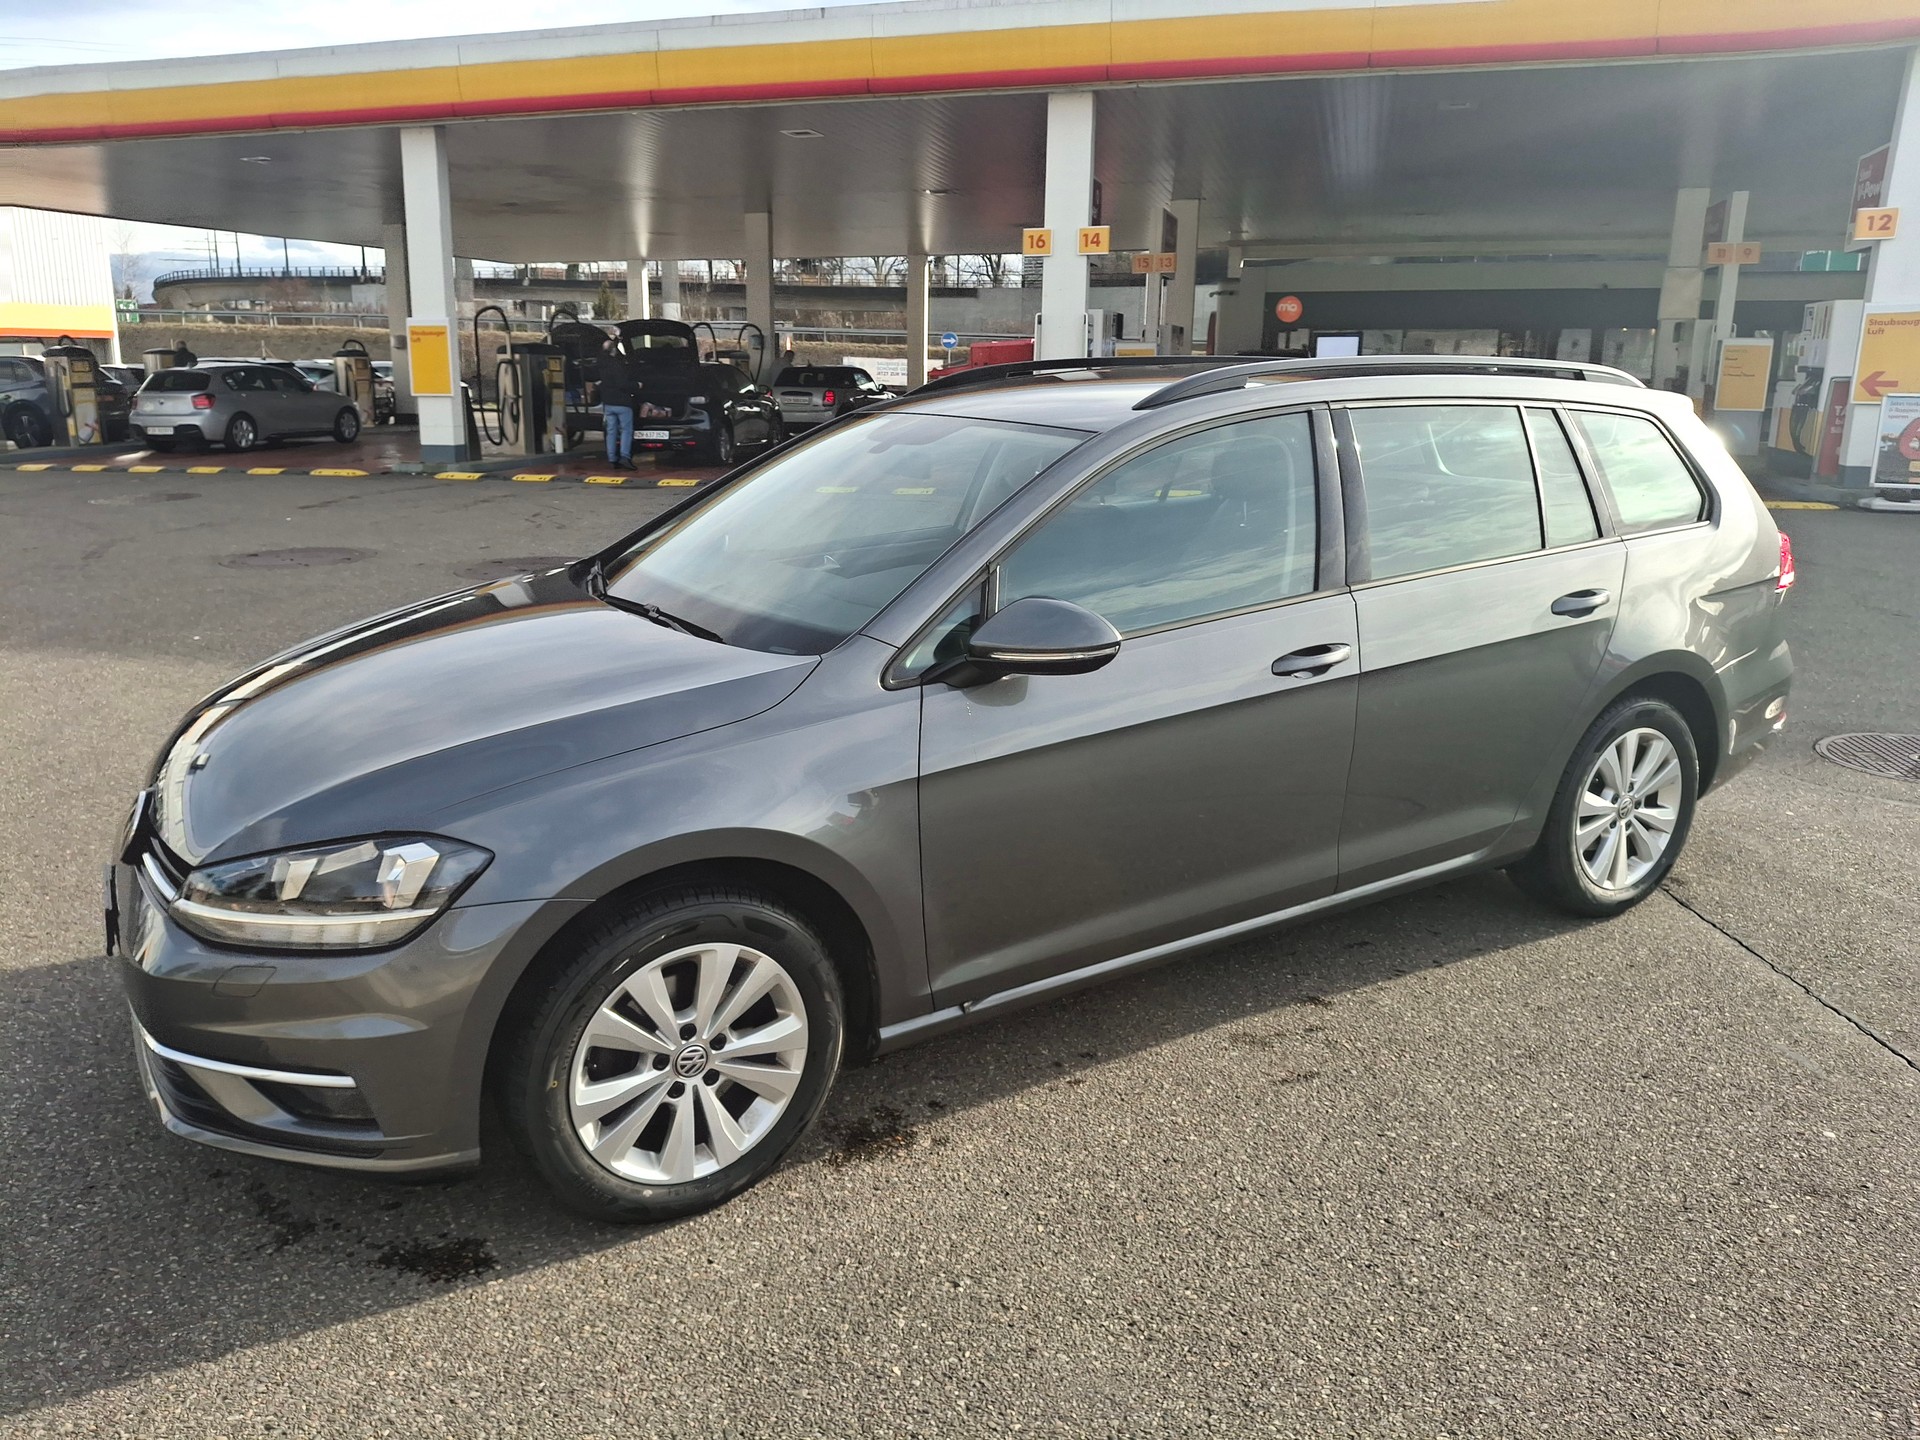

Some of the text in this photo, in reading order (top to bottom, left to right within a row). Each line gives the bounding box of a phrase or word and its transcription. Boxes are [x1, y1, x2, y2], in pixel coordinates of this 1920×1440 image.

[1867, 214, 1893, 231] 12
[1027, 234, 1046, 249] 16
[1082, 232, 1101, 248] 14
[1136, 257, 1150, 269] 15
[1159, 257, 1173, 268] 13
